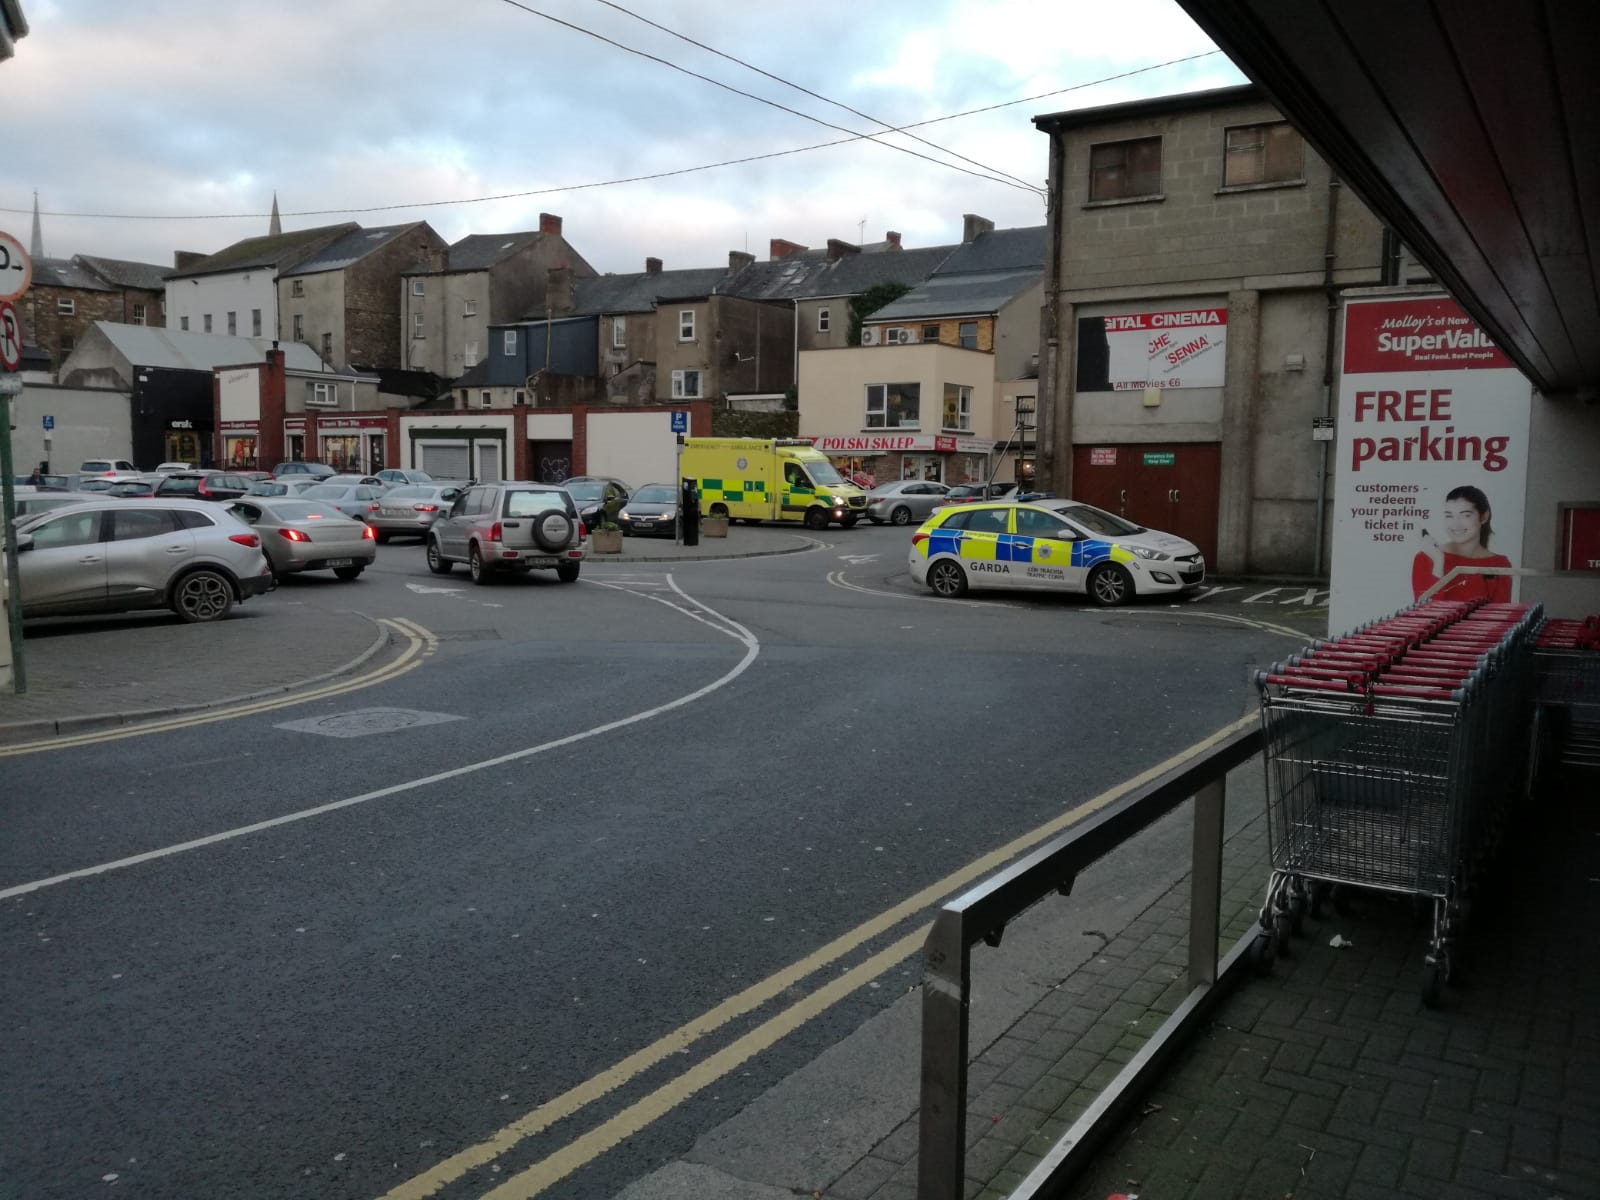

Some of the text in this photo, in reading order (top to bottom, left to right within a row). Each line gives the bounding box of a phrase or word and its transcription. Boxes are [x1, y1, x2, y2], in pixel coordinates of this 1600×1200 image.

[1151, 311, 1220, 327] CINEMA
[1381, 314, 1470, 333] Molloy's of New
[1414, 353, 1431, 361] Real
[1451, 352, 1468, 360] Real
[1468, 351, 1494, 360] People
[1168, 377, 1182, 388] €6
[1354, 388, 1453, 423] FREE
[675, 413, 683, 421] P
[822, 436, 914, 450] POLSKI SKLEP
[1351, 426, 1510, 472] parking
[1355, 482, 1419, 494] customers
[1368, 494, 1417, 505] redeem
[1351, 506, 1430, 520] your parking
[1364, 519, 1414, 531] ticket in
[1373, 532, 1405, 543] store
[969, 561, 1011, 575] GARDA
